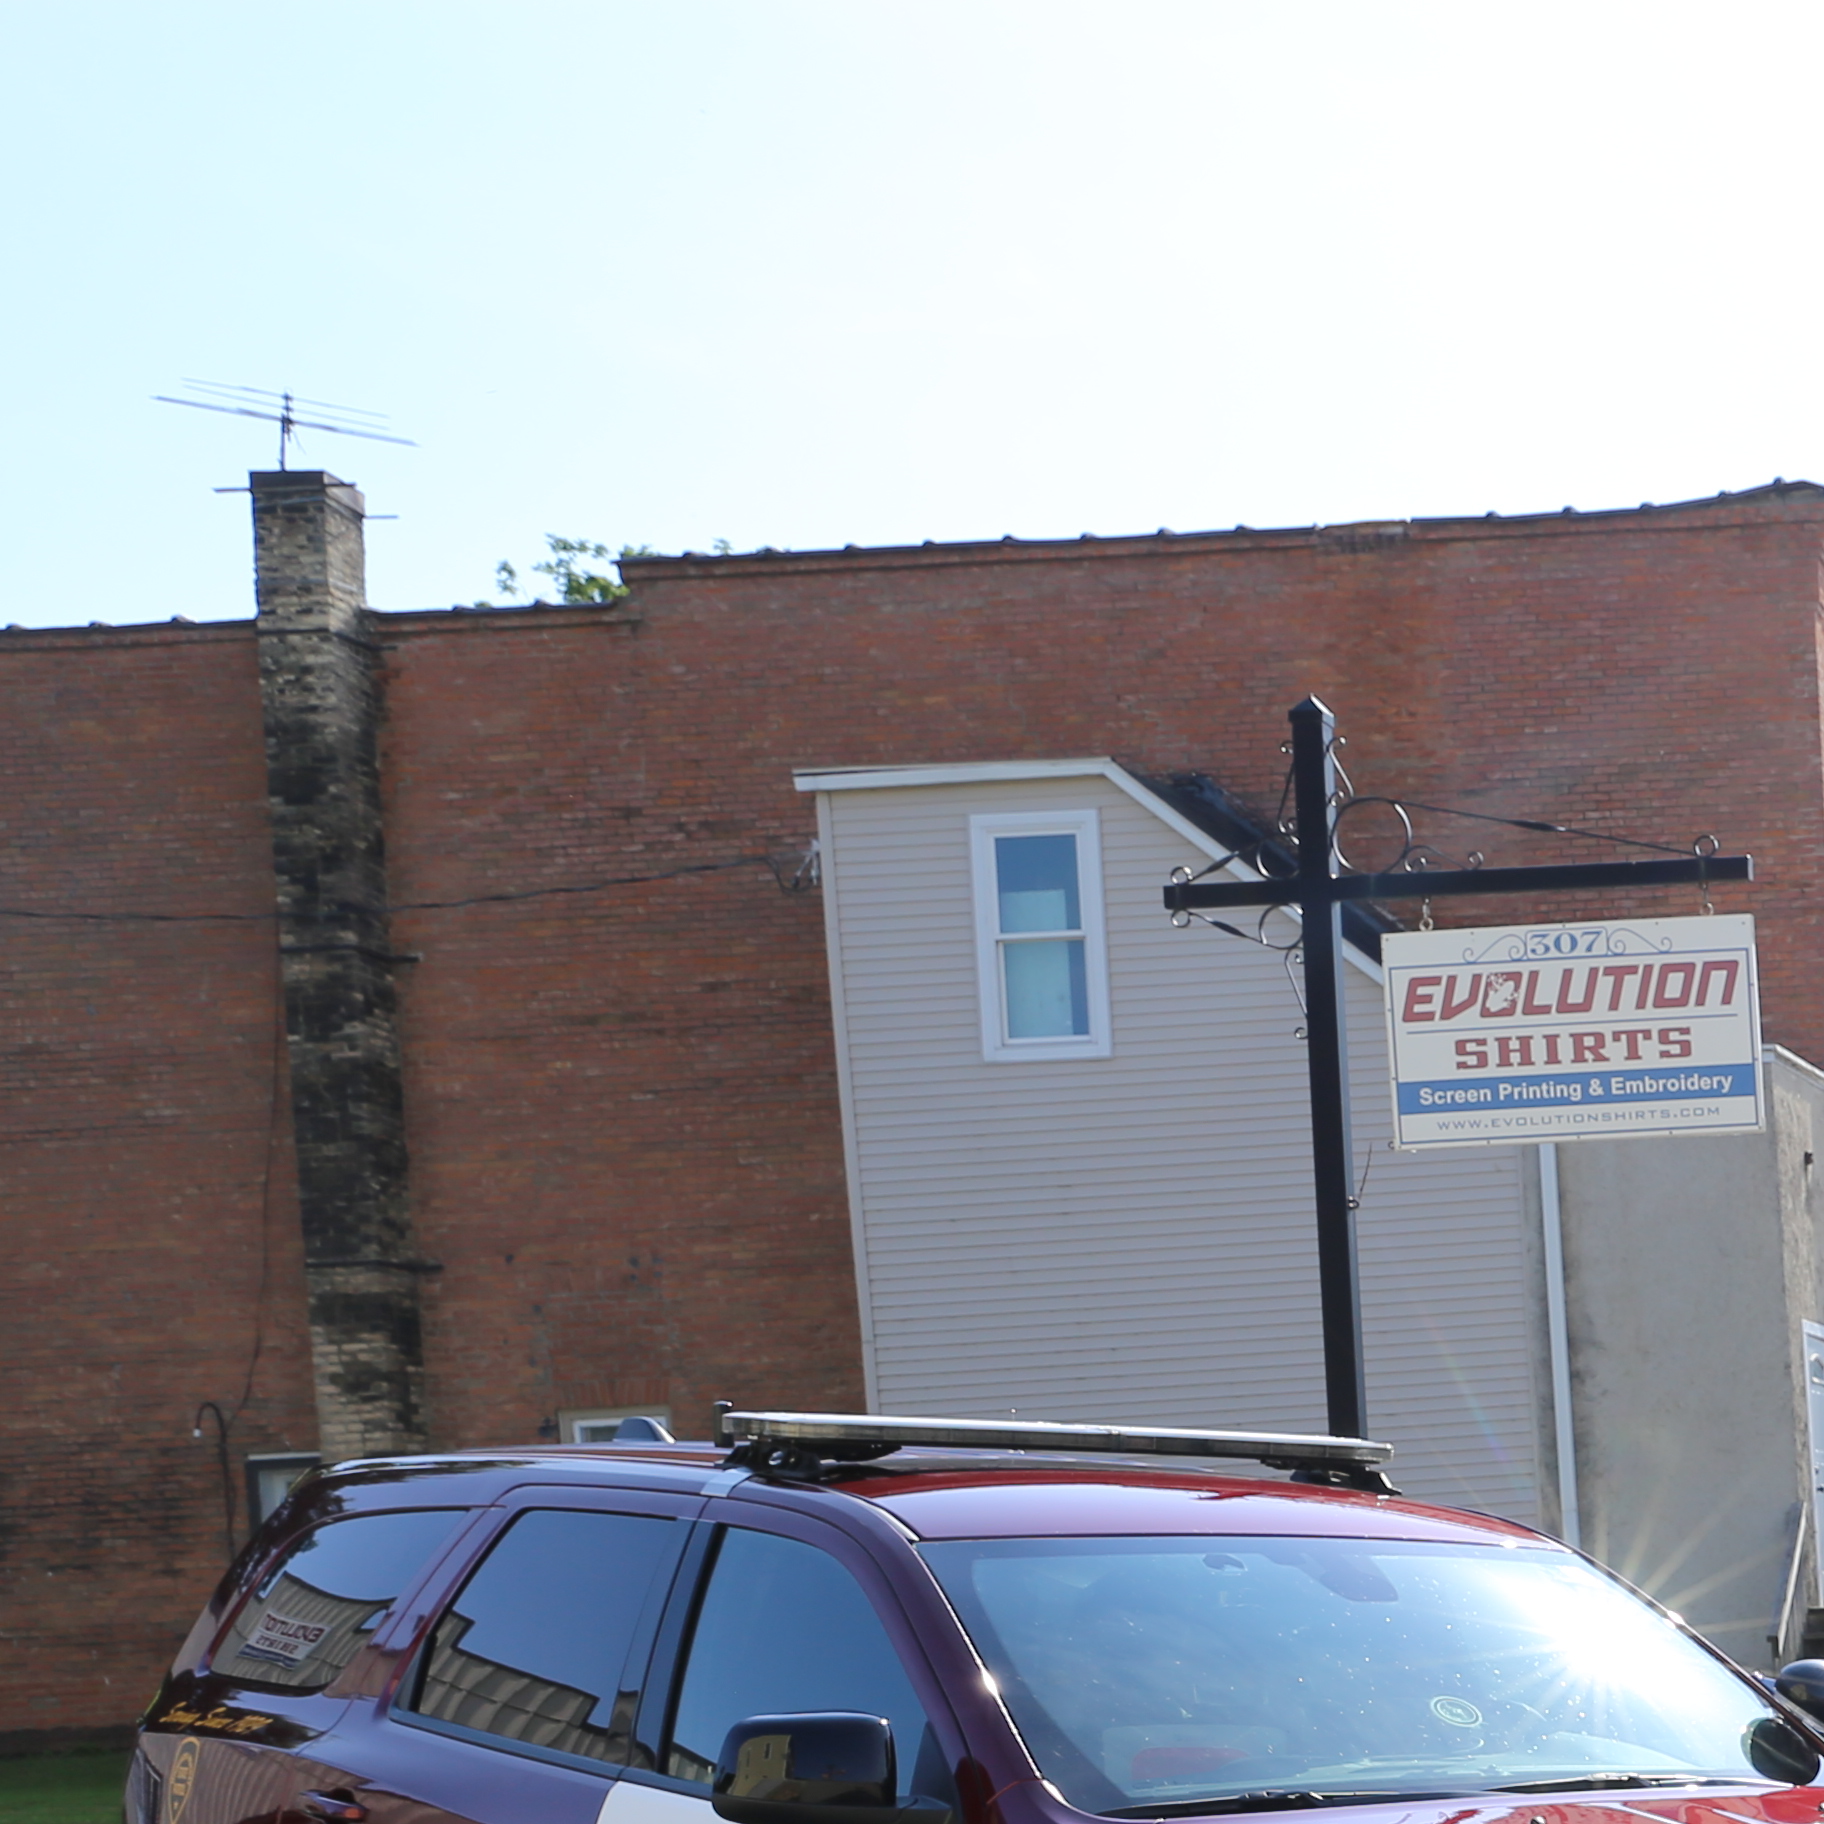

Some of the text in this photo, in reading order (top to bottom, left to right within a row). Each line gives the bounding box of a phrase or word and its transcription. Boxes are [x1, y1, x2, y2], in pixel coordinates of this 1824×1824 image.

[1529, 931, 1603, 957] 307
[1402, 960, 1739, 1023] EVOLUTION
[1455, 1027, 1692, 1070] SHIRTS
[1419, 1073, 1733, 1106] Screen Printing & Embroidery
[1437, 1107, 1720, 1131] WWW.EVOLUTIONSHIRTS.COM
